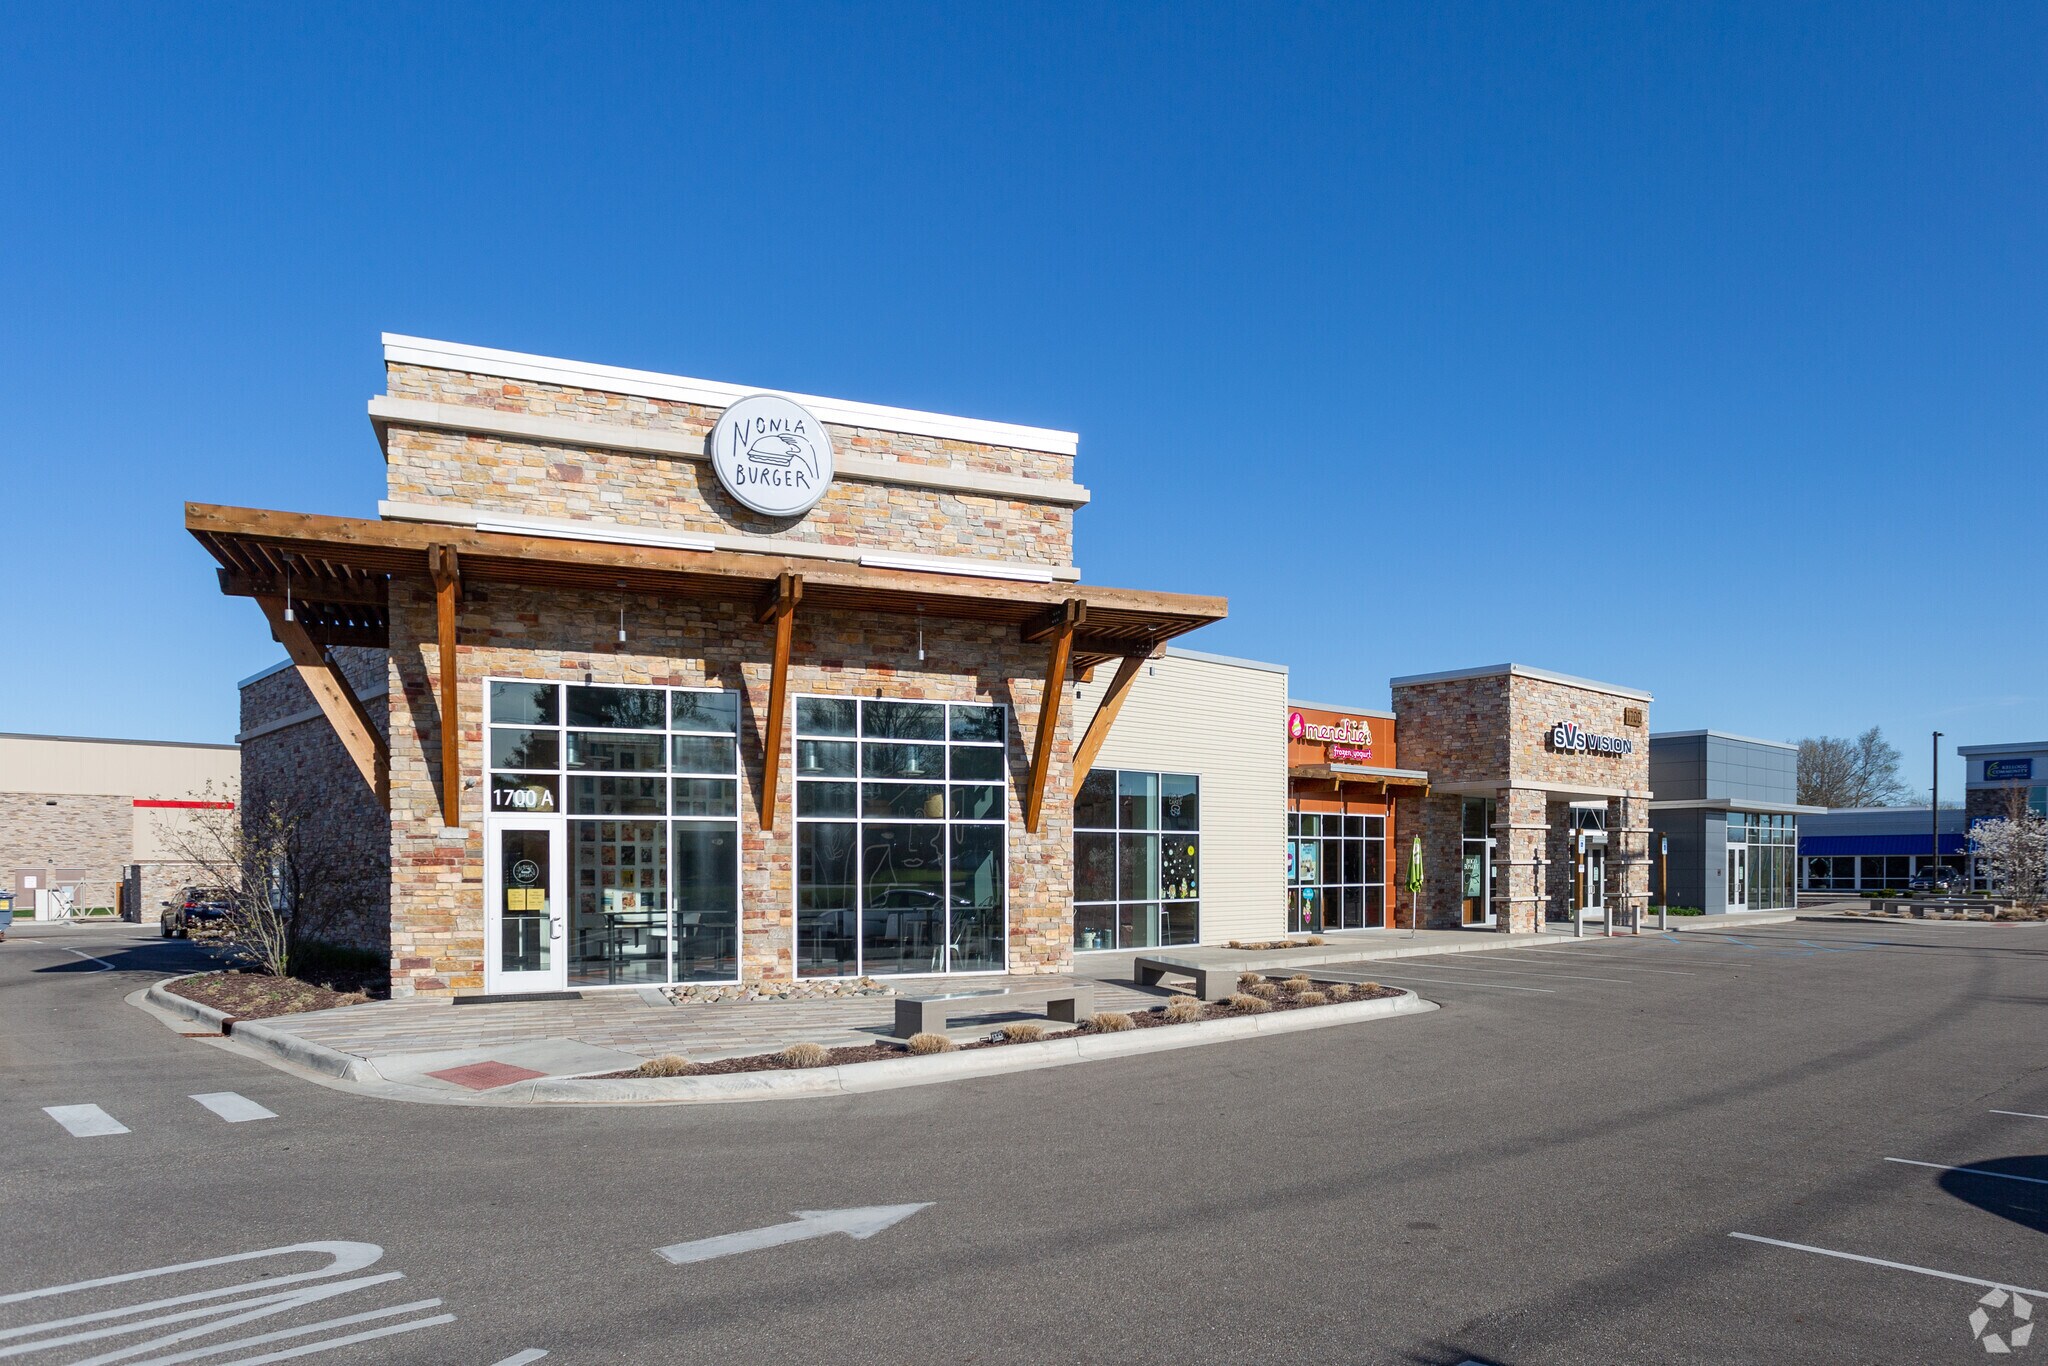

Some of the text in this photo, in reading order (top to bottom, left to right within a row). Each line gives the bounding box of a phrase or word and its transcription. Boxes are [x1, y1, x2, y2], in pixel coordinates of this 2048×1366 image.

[733, 416, 806, 457] NONLA
[736, 464, 811, 489] BURGER
[1627, 710, 1642, 724] 1700
[1306, 718, 1373, 745] menchie's
[1333, 745, 1373, 760] frozen yogurt
[1588, 734, 1632, 753] VISION
[493, 788, 554, 807] 1700 A
